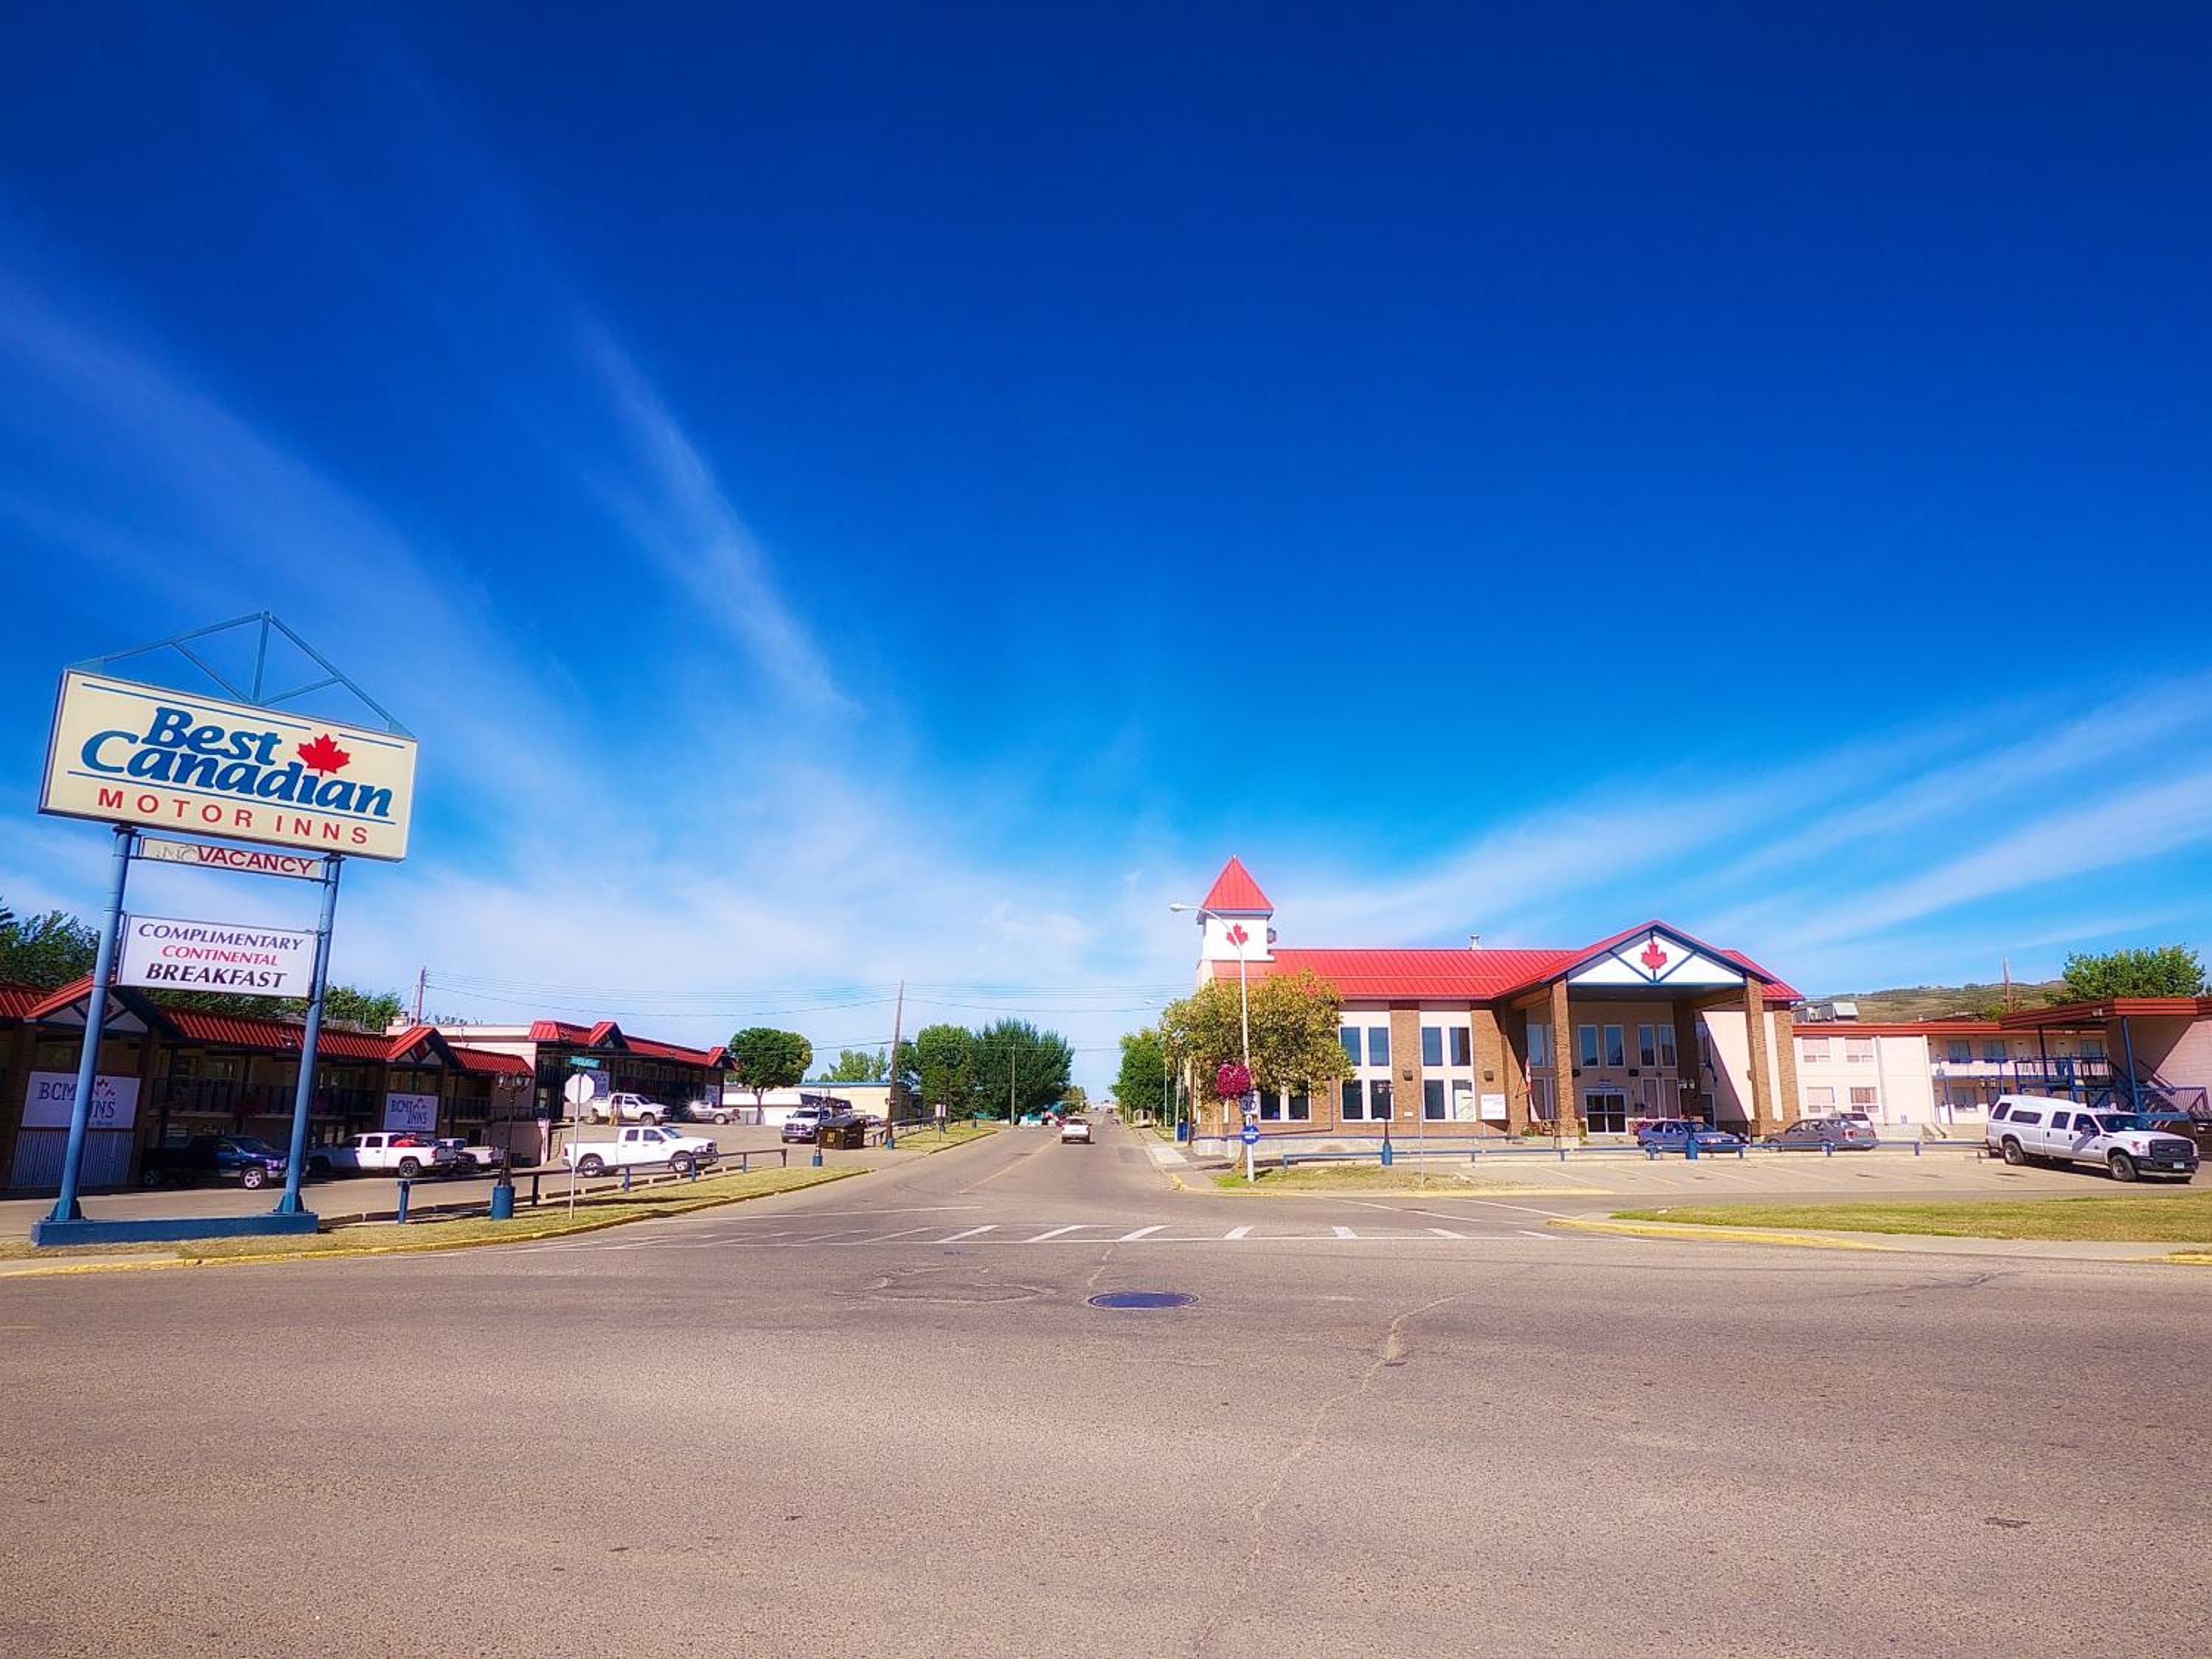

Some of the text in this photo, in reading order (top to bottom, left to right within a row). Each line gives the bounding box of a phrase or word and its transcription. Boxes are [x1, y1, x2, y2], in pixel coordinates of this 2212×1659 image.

[142, 706, 282, 765] Best
[81, 730, 393, 817] Canadian
[98, 788, 368, 844] MOTOR INNS
[198, 846, 314, 874] VACANCY
[139, 923, 304, 951] COMPLIMENTARY
[162, 945, 278, 966] CONTINENTAL
[145, 963, 287, 988] BREAKFAST
